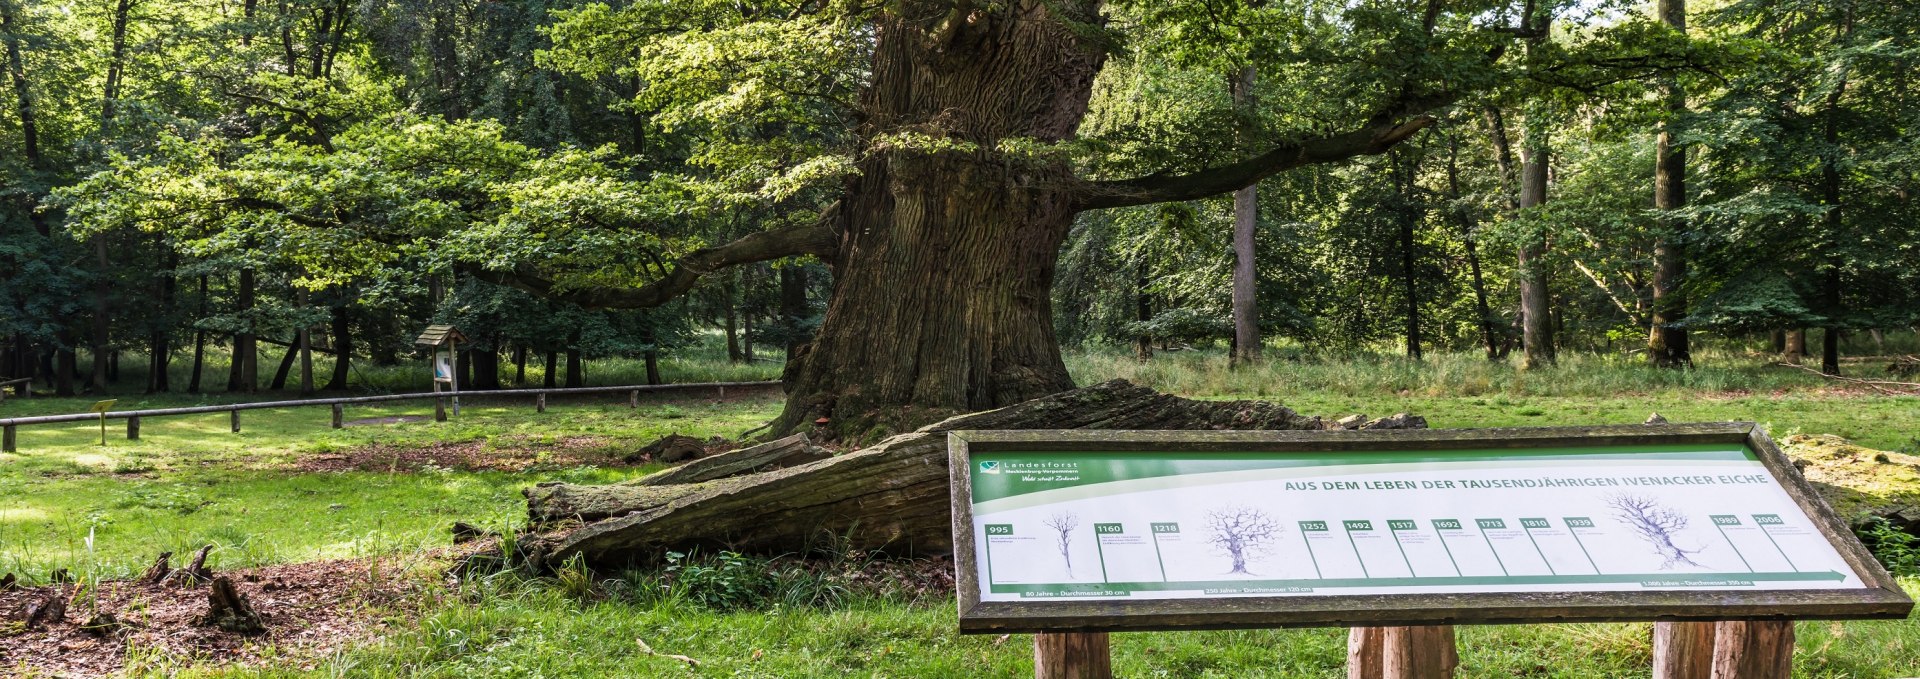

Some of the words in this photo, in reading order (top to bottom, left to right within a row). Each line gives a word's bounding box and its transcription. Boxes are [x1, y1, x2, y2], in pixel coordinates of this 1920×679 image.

[1285, 481, 1318, 491] AUS
[1321, 481, 1360, 490] DEM
[1364, 480, 1417, 490] LEBEN
[1422, 480, 1457, 489] DER
[1458, 478, 1618, 489] TAUSENDJÄHRIGEN
[1622, 476, 1716, 487] IVENACKER
[1720, 474, 1769, 484] EICHE
[1301, 523, 1326, 531] 1252
[1346, 522, 1371, 530] 1492
[1435, 521, 1460, 529] 1692
[1523, 520, 1547, 528] 1810
[989, 526, 1009, 534] 995
[1097, 525, 1121, 533] 1160
